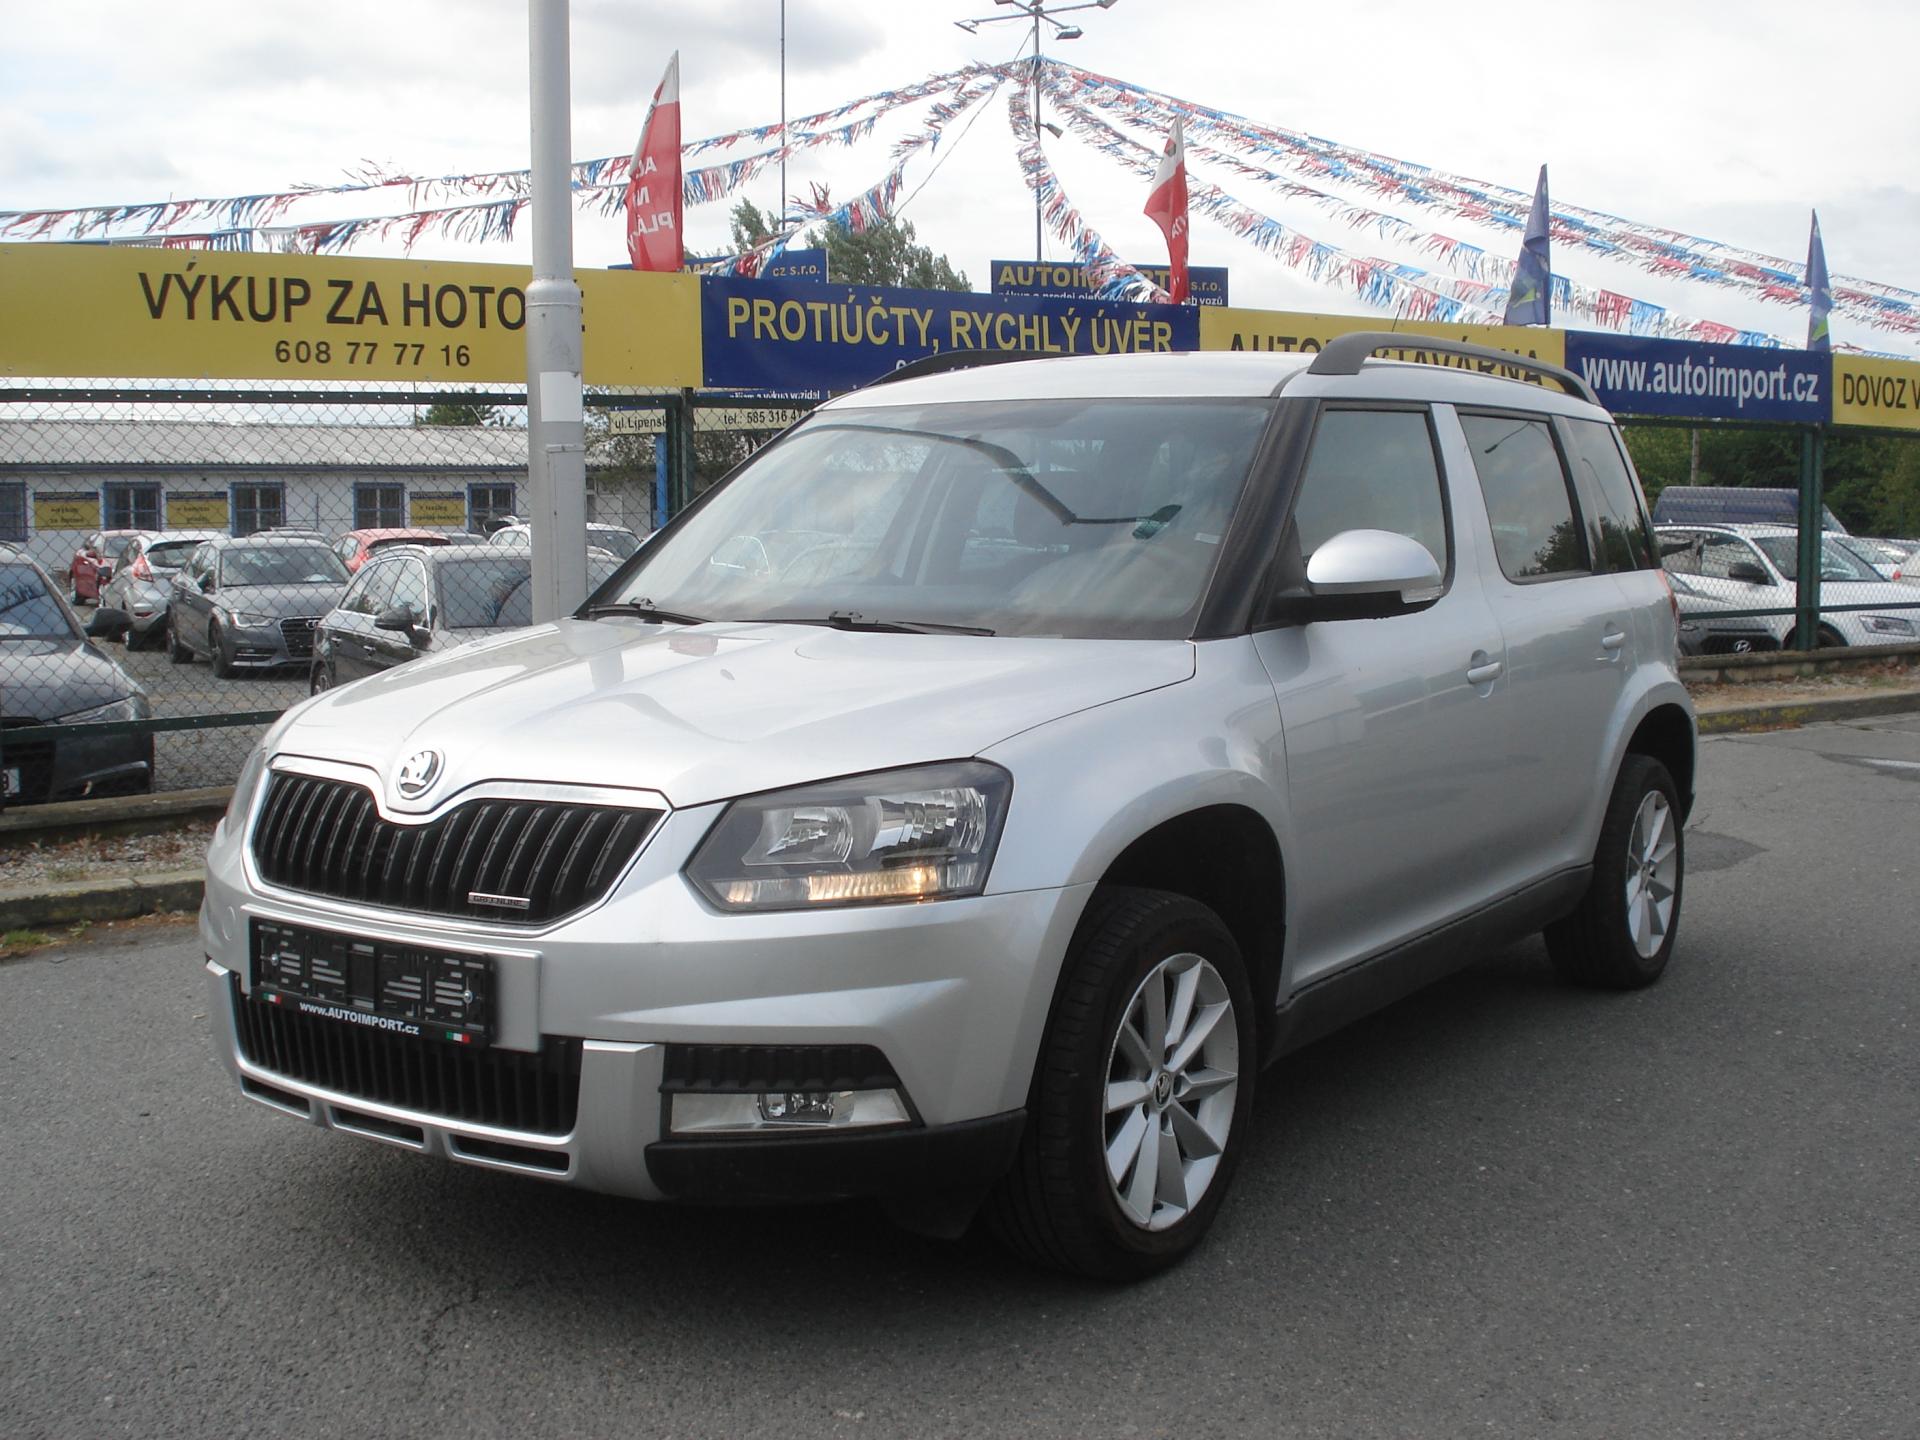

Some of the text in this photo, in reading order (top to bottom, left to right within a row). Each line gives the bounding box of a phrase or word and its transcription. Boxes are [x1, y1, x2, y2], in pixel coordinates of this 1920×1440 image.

[790, 265, 821, 276] s.r.o.
[138, 262, 311, 322] VÝKUP
[326, 279, 389, 326] ZA
[1191, 281, 1222, 292] s.r.o.
[1200, 297, 1223, 306] vozů
[727, 293, 1172, 354] PROTIÚČTY, RYCHLÝ ÚVĚR
[275, 340, 470, 367] 608 77 77 16
[1582, 356, 1819, 408] www.autoimport.cz
[1842, 373, 1907, 408] DOVOZ
[747, 411, 765, 424] 585
[768, 410, 787, 423] 316
[299, 1002, 420, 1035] www.AUTOIMPORT.cz
